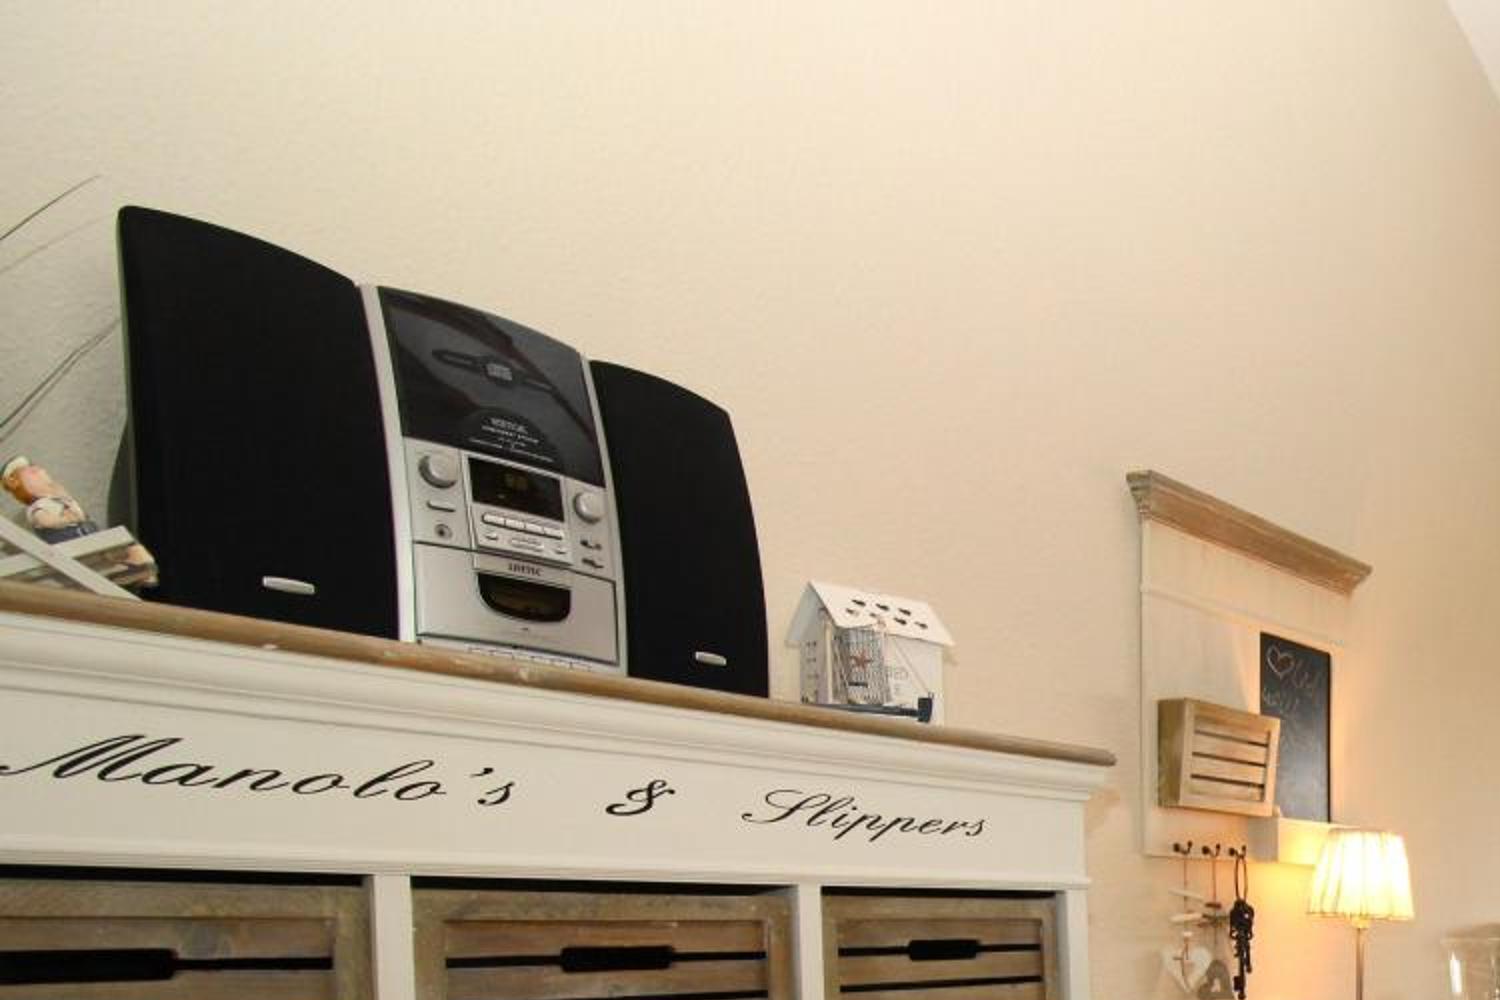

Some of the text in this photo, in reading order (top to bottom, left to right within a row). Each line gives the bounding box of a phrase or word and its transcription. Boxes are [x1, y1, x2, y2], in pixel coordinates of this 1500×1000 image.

[0, 733, 986, 843] Manolo's & Slippers
